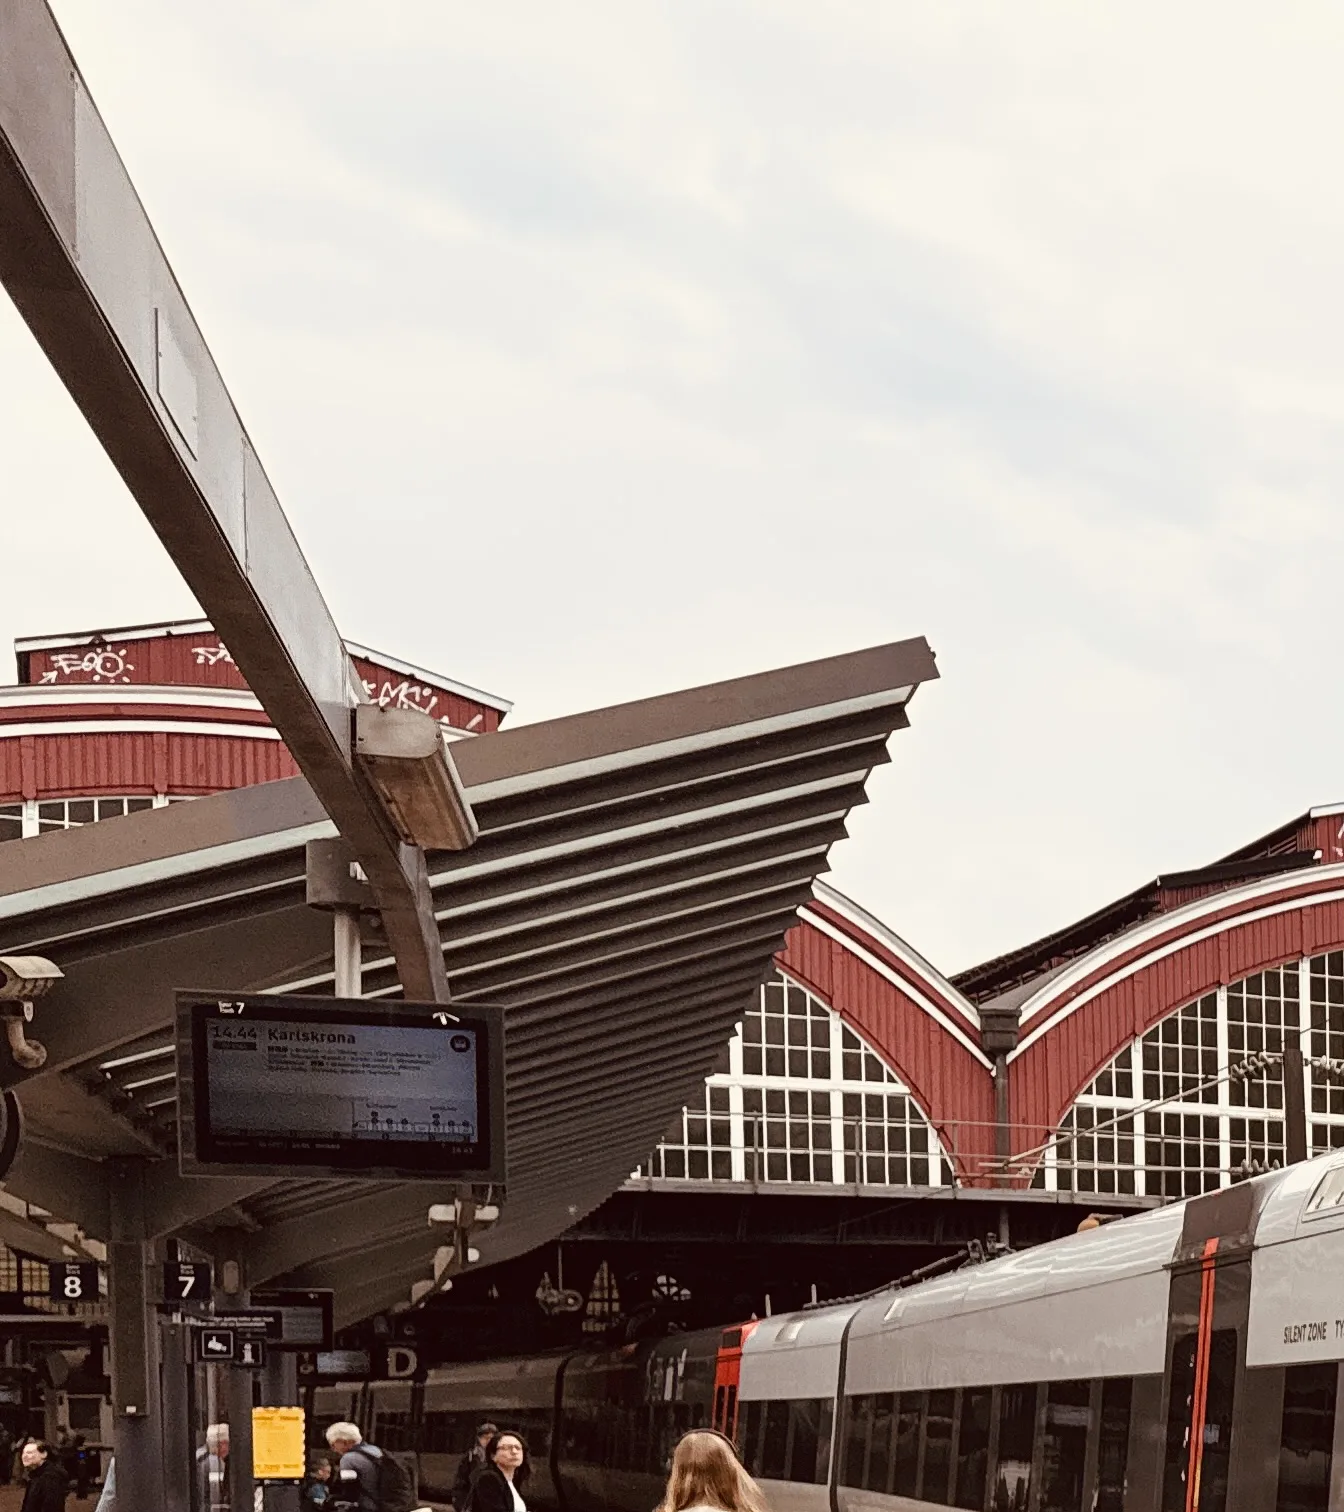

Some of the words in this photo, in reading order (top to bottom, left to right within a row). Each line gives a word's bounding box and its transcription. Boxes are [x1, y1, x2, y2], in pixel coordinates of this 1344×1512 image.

[268, 1028, 356, 1044] Karlskrona
[64, 1276, 82, 1298] 8
[178, 1276, 196, 1298] 7
[1284, 1324, 1306, 1344] SILENT
[1307, 1322, 1327, 1342] ZONE
[387, 1348, 418, 1378] D
